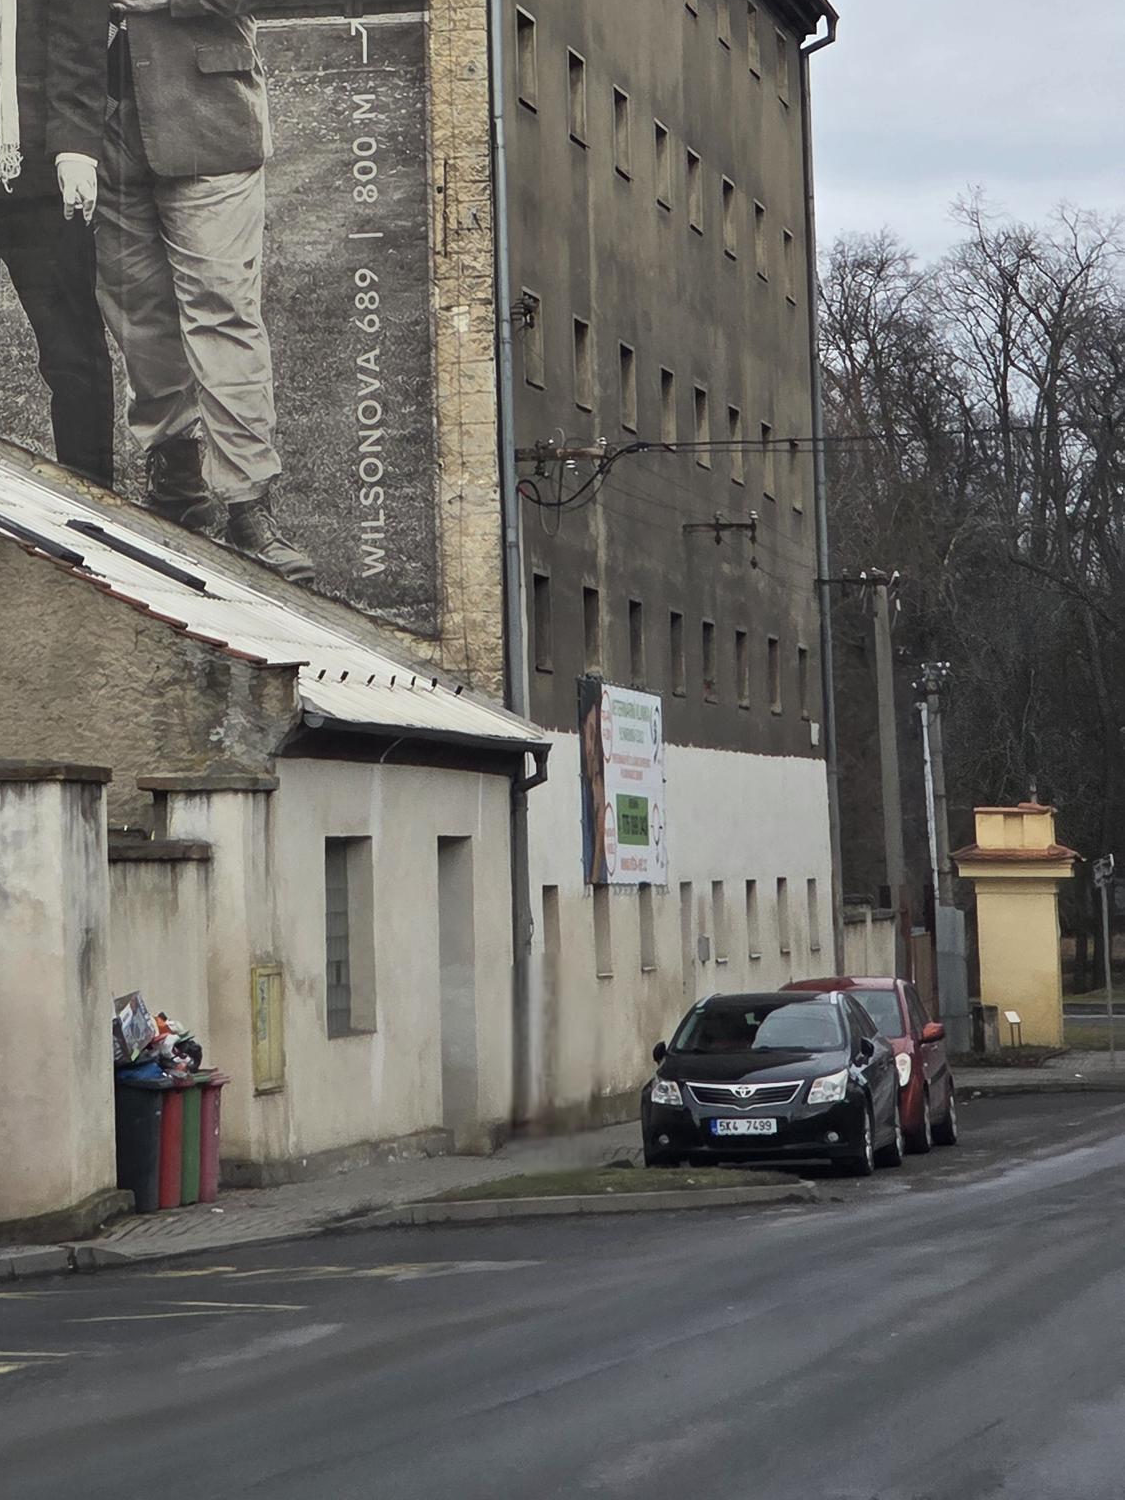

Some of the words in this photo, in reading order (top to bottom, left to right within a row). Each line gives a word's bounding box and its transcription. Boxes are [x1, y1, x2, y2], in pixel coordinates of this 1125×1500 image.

[352, 94, 377, 120] M
[353, 137, 378, 203] 800
[355, 267, 381, 334] 689
[356, 348, 385, 578] WILSONOVA
[746, 1120, 772, 1131] 7499
